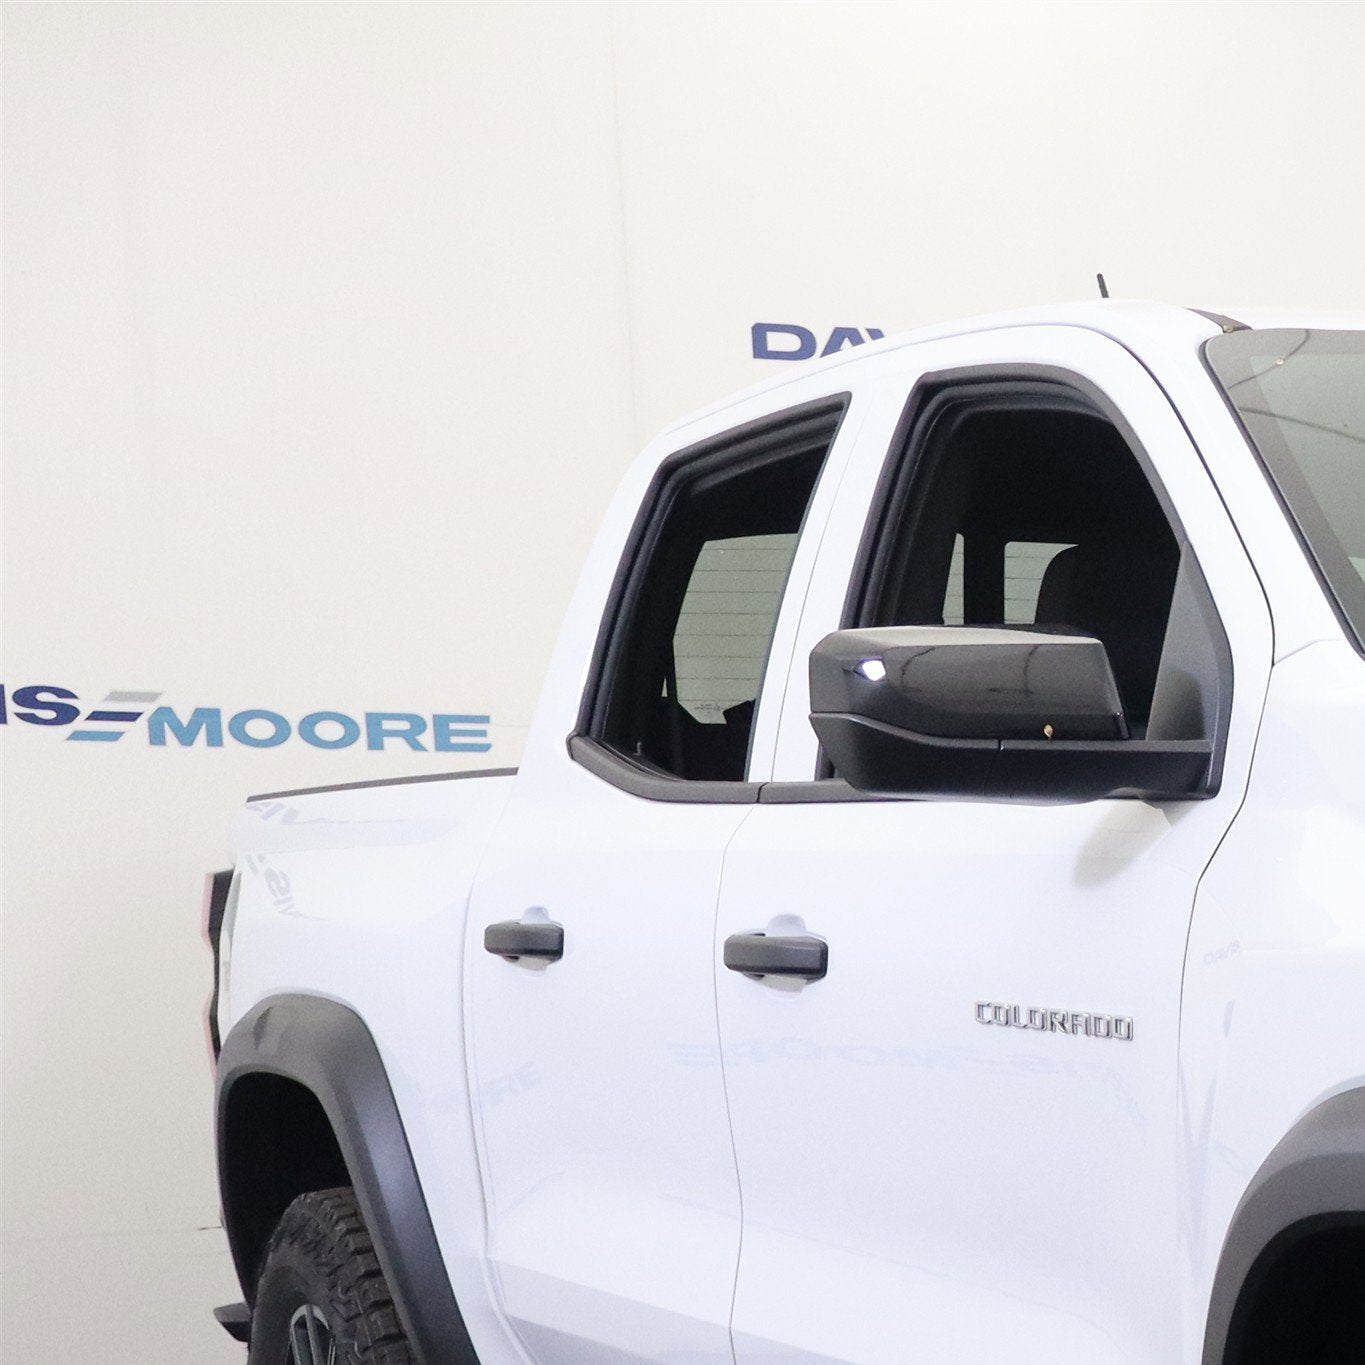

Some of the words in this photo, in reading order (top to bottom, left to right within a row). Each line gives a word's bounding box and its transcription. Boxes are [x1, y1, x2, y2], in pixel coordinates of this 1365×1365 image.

[751, 322, 885, 361] DA
[147, 705, 493, 754] MOORE
[975, 1000, 1135, 1042] COLORADO
